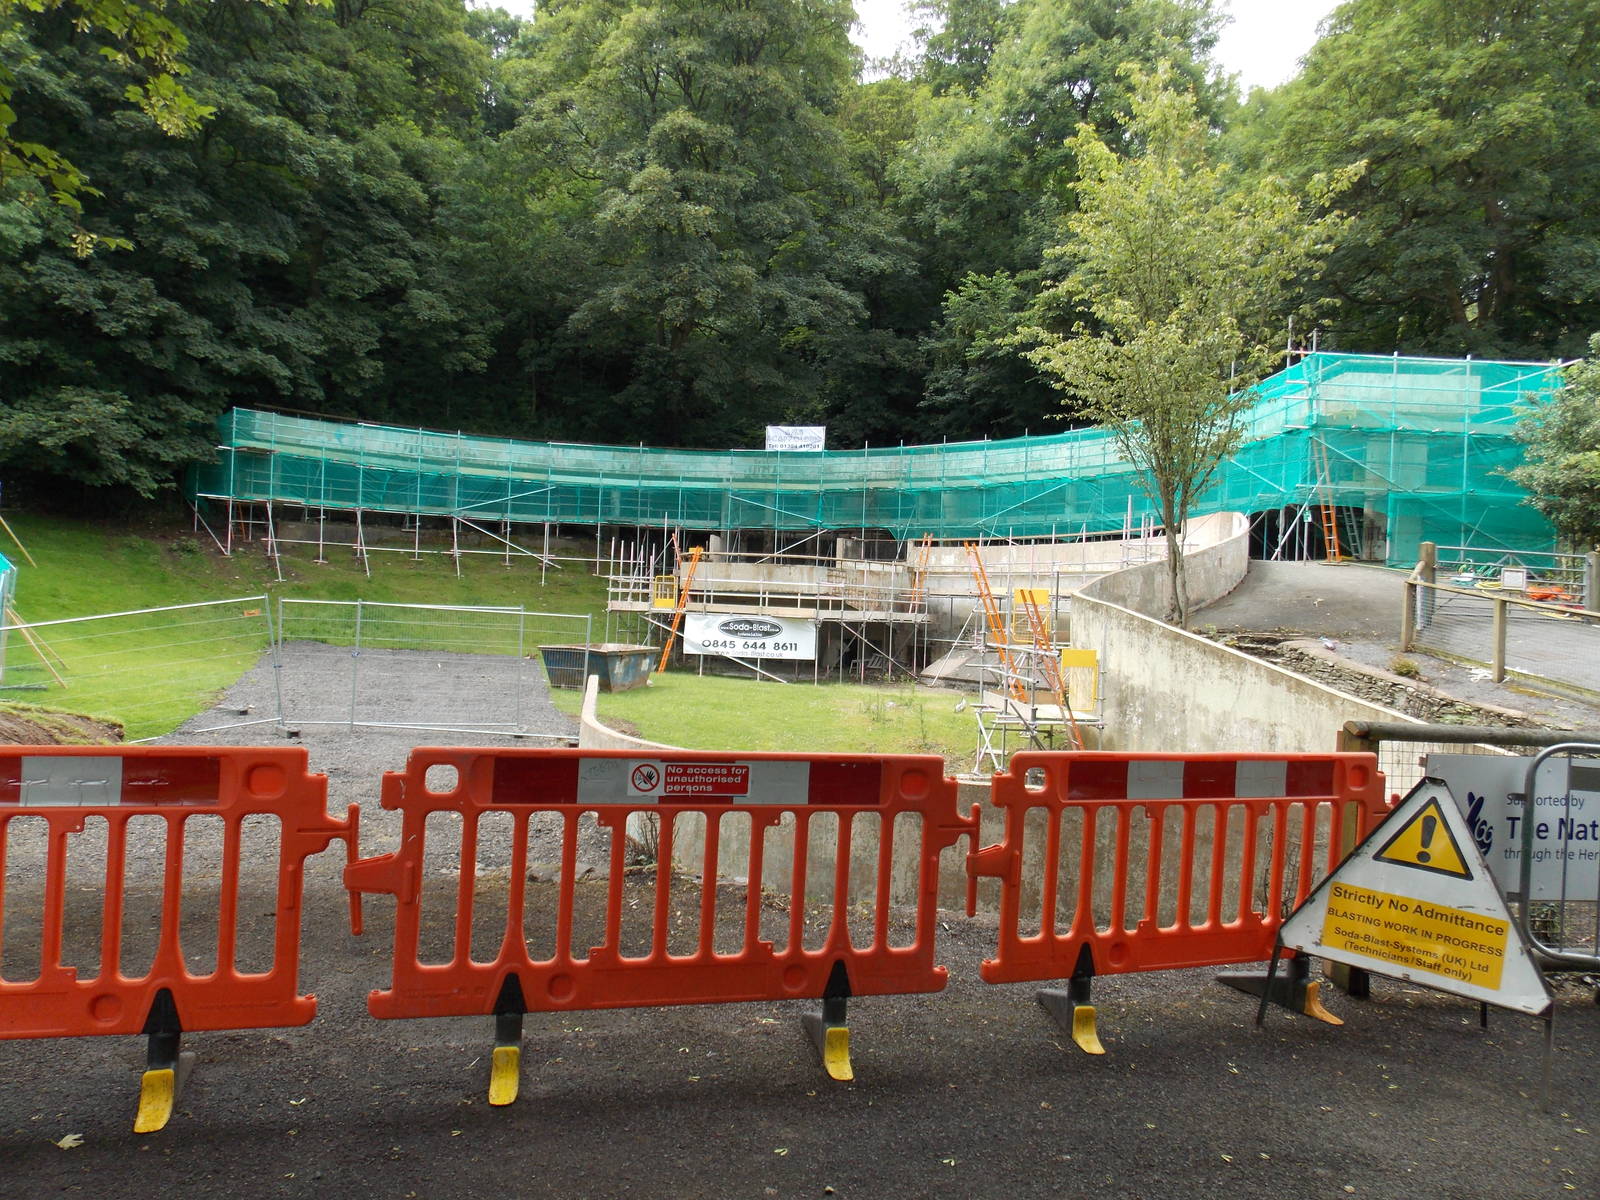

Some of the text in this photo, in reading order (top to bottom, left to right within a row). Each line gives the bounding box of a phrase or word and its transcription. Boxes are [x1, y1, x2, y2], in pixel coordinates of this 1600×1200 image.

[702, 639, 798, 651] 0845 644 8611
[667, 766, 747, 775] No access for
[667, 775, 741, 783] unauthorised
[666, 784, 713, 793] persons
[1570, 795, 1585, 810] by
[1506, 816, 1549, 840] Te
[1333, 886, 1504, 936] Strictly No Admittance
[1327, 907, 1503, 957] BLASTING WORK IN PROGRESS
[1441, 953, 1467, 969] (UK)
[1470, 961, 1489, 973] Ltd
[1444, 966, 1473, 982] only)
